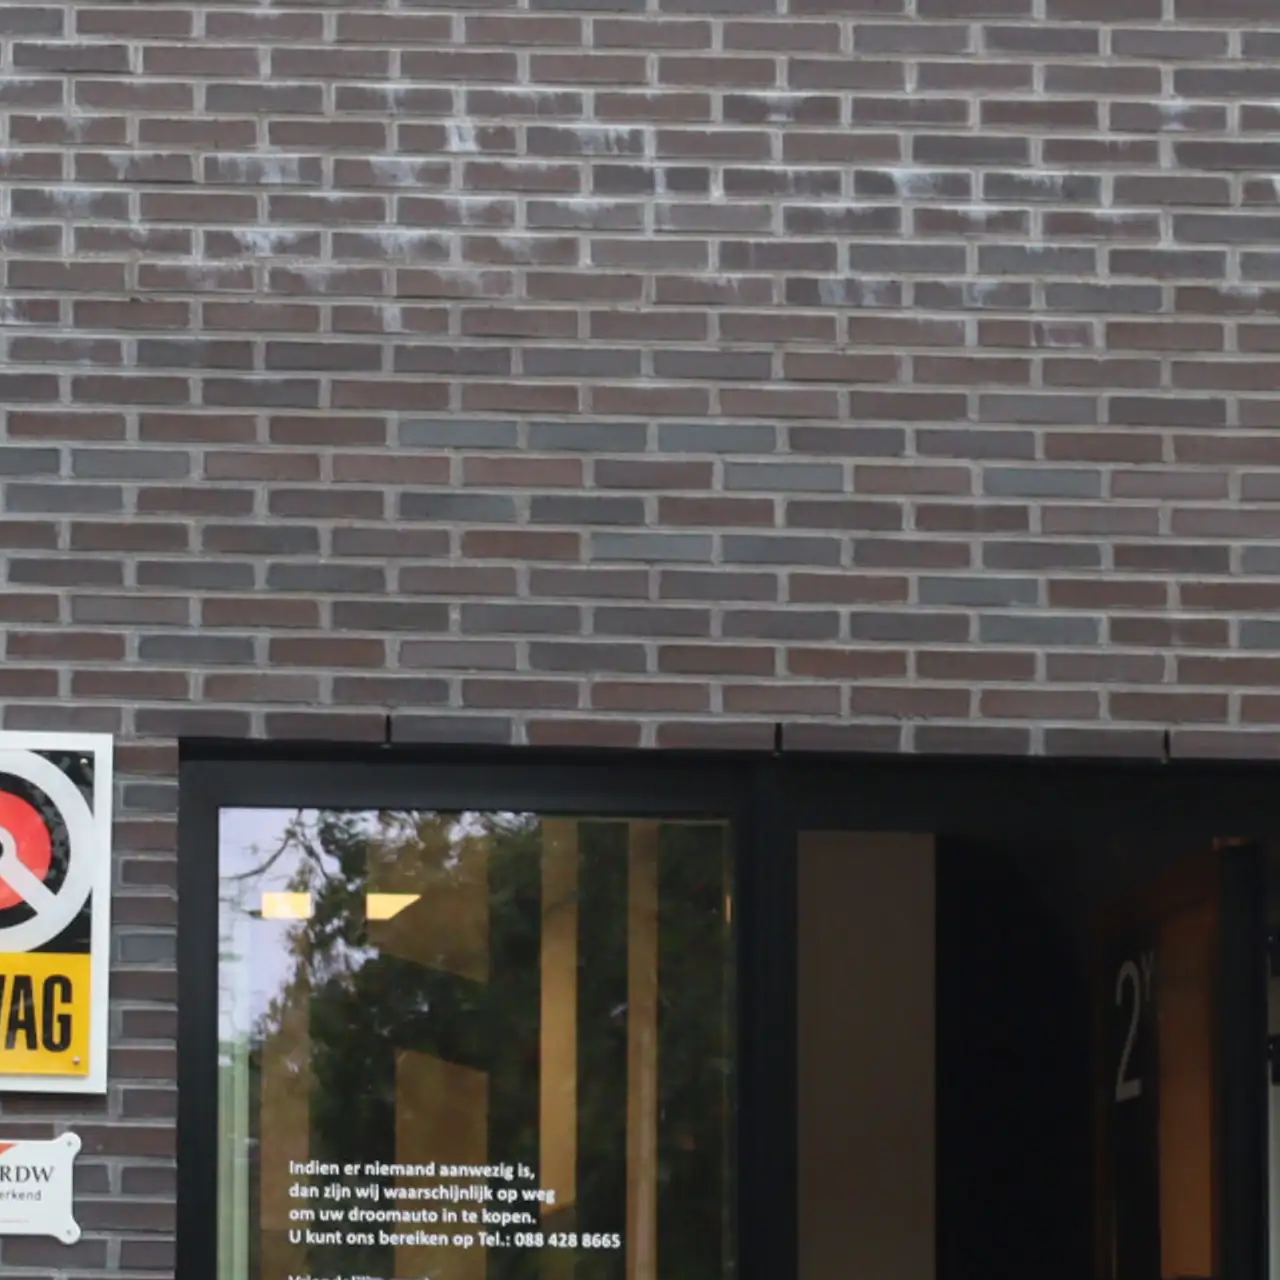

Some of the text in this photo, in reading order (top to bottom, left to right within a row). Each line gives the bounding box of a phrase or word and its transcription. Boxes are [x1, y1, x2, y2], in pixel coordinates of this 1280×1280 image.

[289, 1159, 535, 1181] Indien er niemand aanwezig is,
[288, 1182, 556, 1205] dan zijn wij waarschijnlijk op weg
[288, 1206, 536, 1227] om uw droomauto in te kopen.
[288, 1229, 621, 1249] U kunt ons bereiken op Tel.: 088 428 8665
